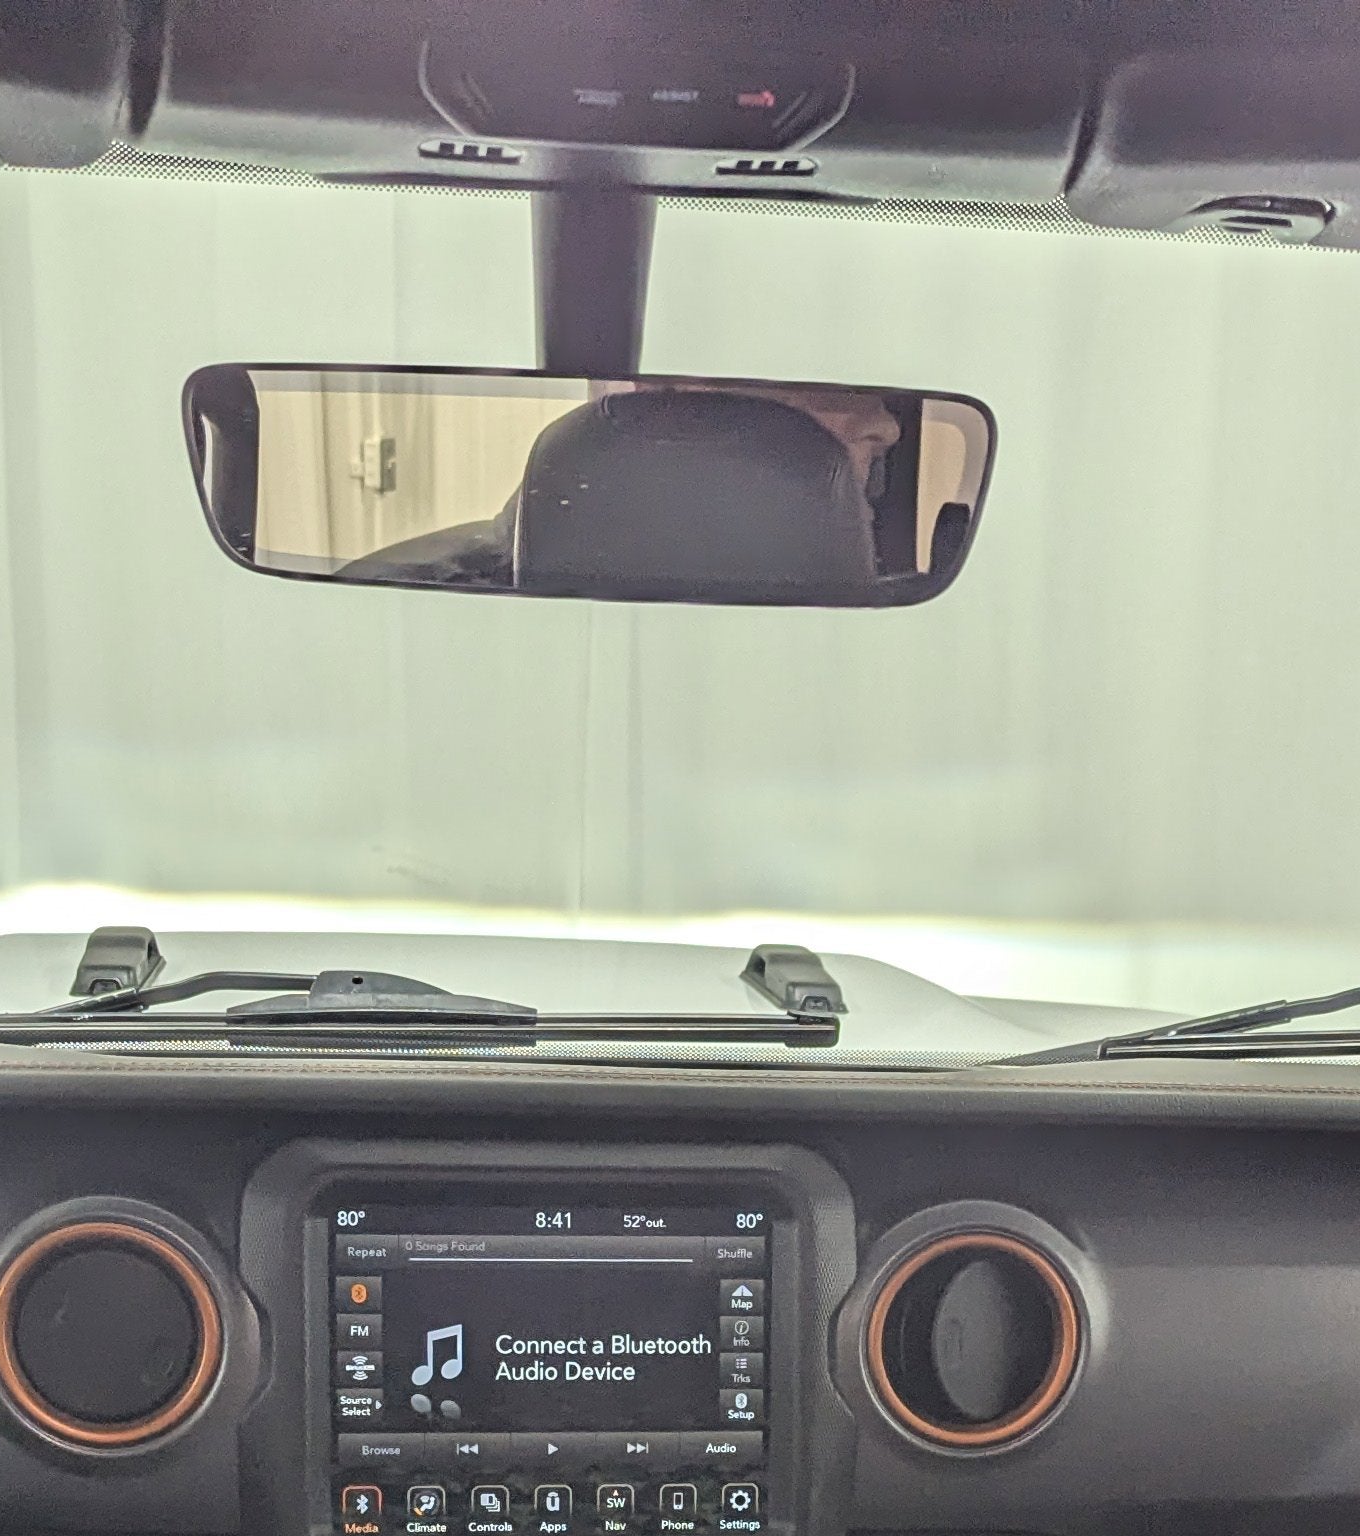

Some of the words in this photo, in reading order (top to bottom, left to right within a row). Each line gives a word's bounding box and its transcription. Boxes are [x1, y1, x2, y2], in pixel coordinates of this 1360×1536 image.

[337, 1211, 366, 1227] 80°
[535, 1212, 572, 1229] 8:41
[736, 1213, 764, 1229] 80°
[416, 1240, 449, 1253] Songs
[451, 1241, 486, 1251] Found
[347, 1246, 387, 1259] Repeat
[717, 1248, 753, 1260] Shuffle
[731, 1299, 753, 1311] Map
[350, 1325, 369, 1337] FM
[495, 1334, 587, 1355] Connect
[591, 1340, 604, 1355] a
[611, 1333, 712, 1355] Bluetooth
[733, 1337, 750, 1347] Info
[495, 1360, 558, 1381] Audio
[565, 1361, 636, 1381] Device
[340, 1396, 373, 1405] Source
[342, 1407, 371, 1416] Select
[727, 1410, 755, 1421] Setup
[362, 1446, 401, 1456] Browse
[705, 1443, 737, 1454] Audio
[606, 1498, 625, 1508] SW
[345, 1523, 379, 1534] Media
[406, 1522, 447, 1533] Climate
[468, 1521, 513, 1532] Controls
[539, 1522, 568, 1533] Apps
[605, 1521, 627, 1531] Nav
[661, 1520, 694, 1530] Phone
[719, 1520, 761, 1532] Settings
